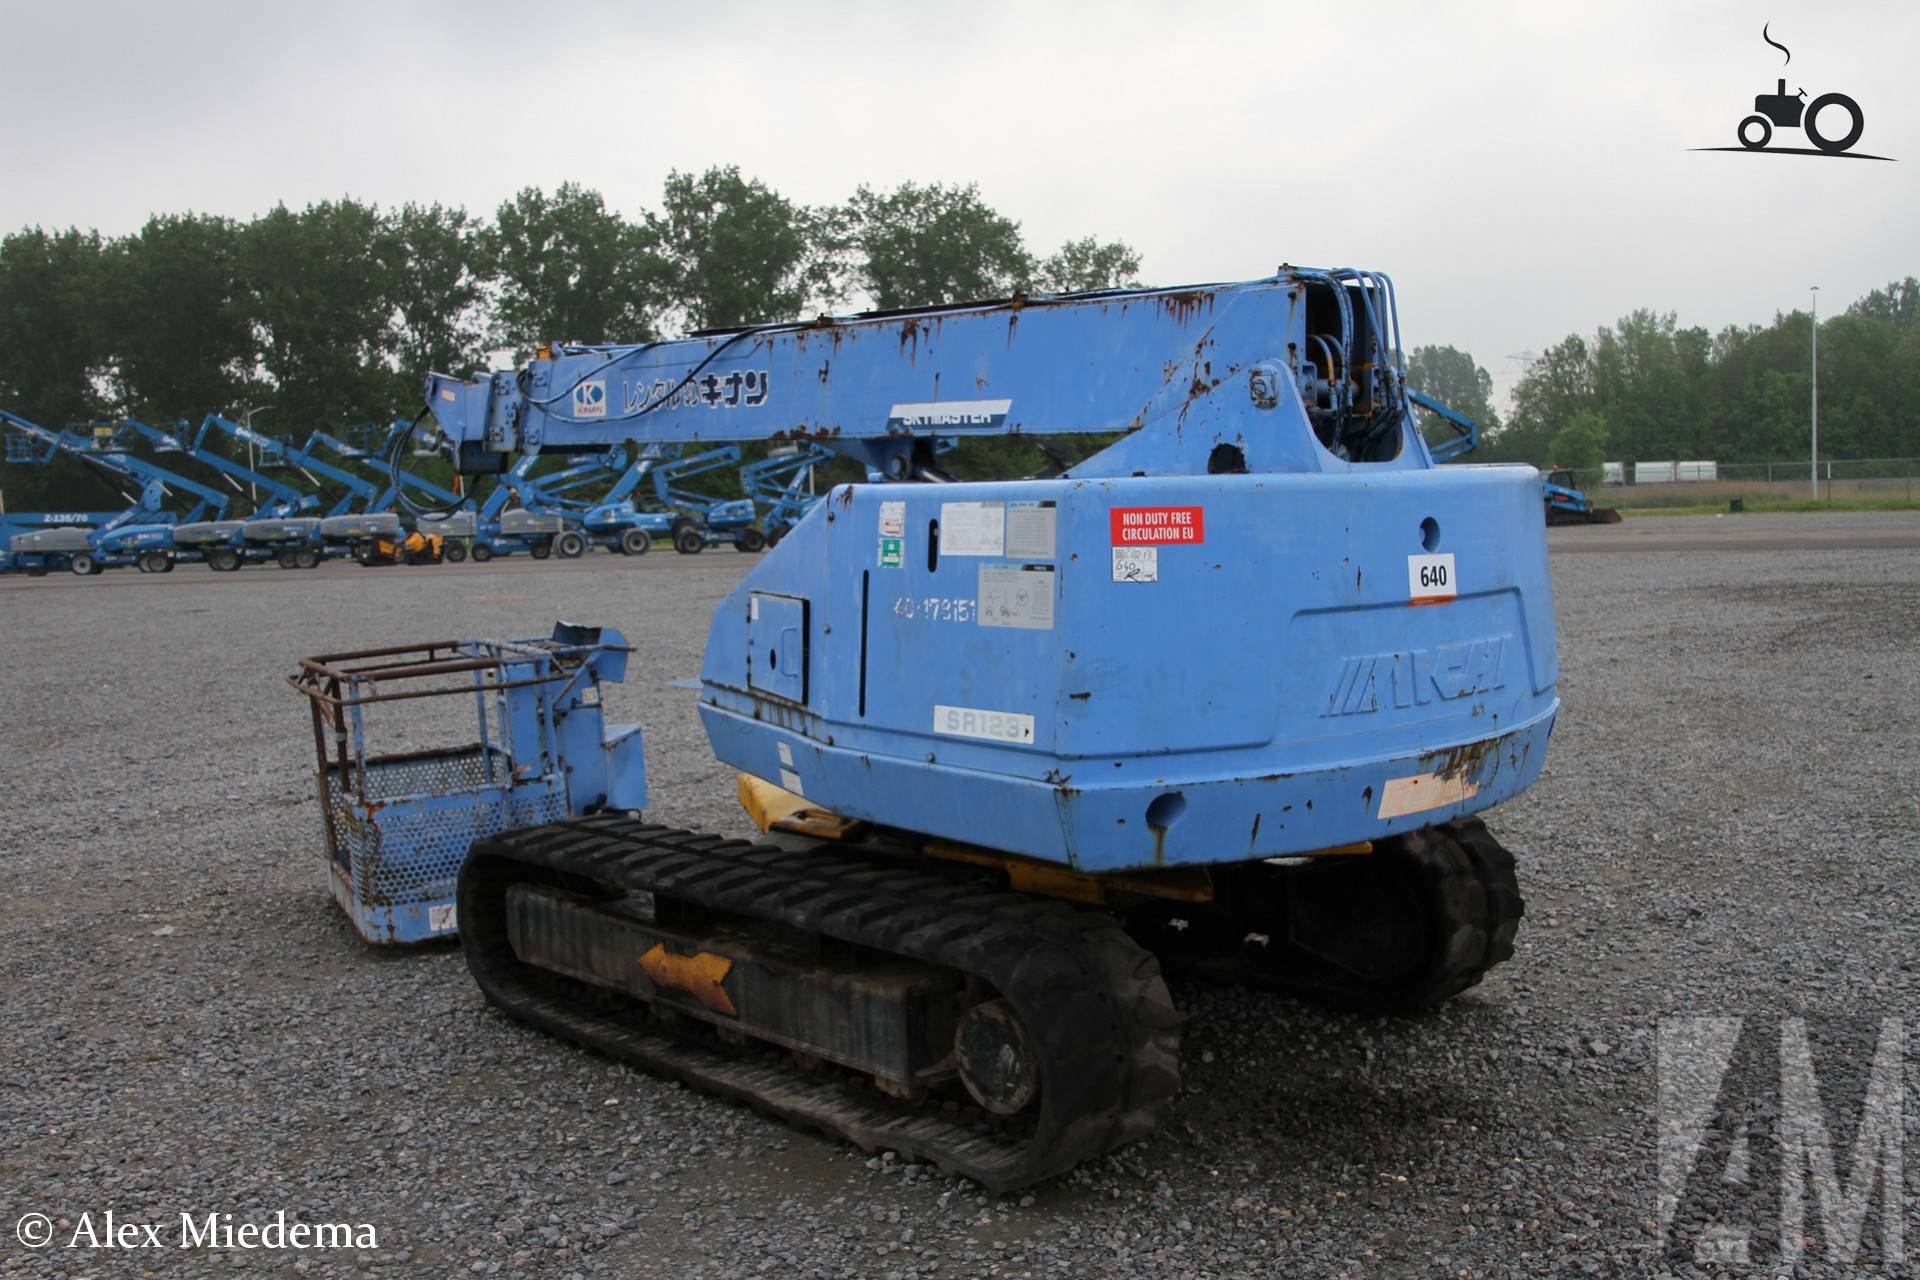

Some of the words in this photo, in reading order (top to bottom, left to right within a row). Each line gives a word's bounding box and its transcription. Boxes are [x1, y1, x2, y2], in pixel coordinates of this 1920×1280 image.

[1123, 513, 1143, 525] NON
[1145, 513, 1168, 525] DUTY
[1171, 512, 1192, 525] FREE
[1122, 527, 1180, 541] CIRCULATION
[1182, 527, 1194, 540] EU
[1419, 565, 1447, 587] 640
[947, 709, 1021, 739] SR123
